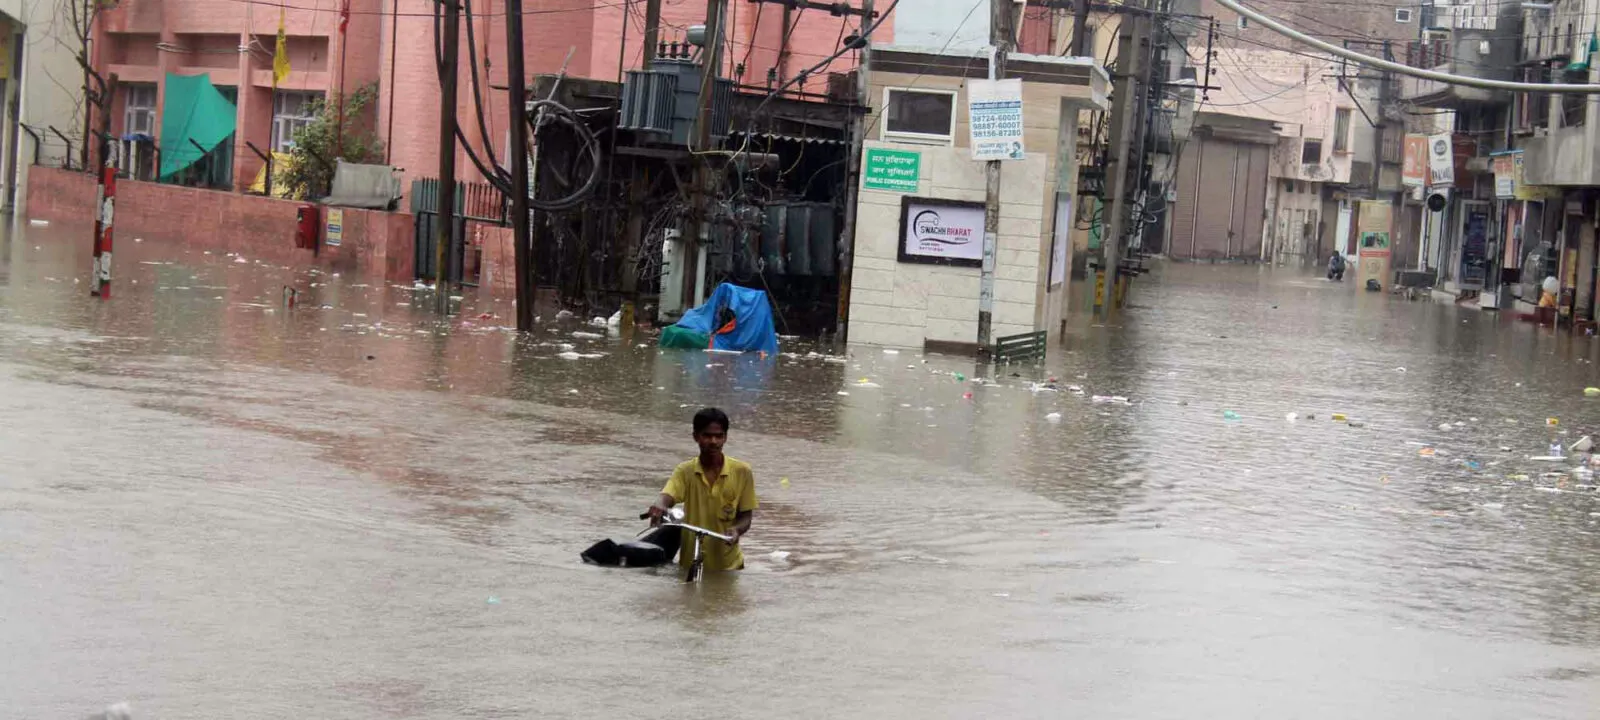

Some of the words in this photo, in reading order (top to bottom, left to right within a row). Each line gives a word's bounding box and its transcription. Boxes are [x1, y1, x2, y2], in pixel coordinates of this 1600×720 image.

[884, 178, 916, 186] CONVENIENCE
[920, 226, 946, 235] SWACHH
[947, 227, 972, 236] BHARAT
